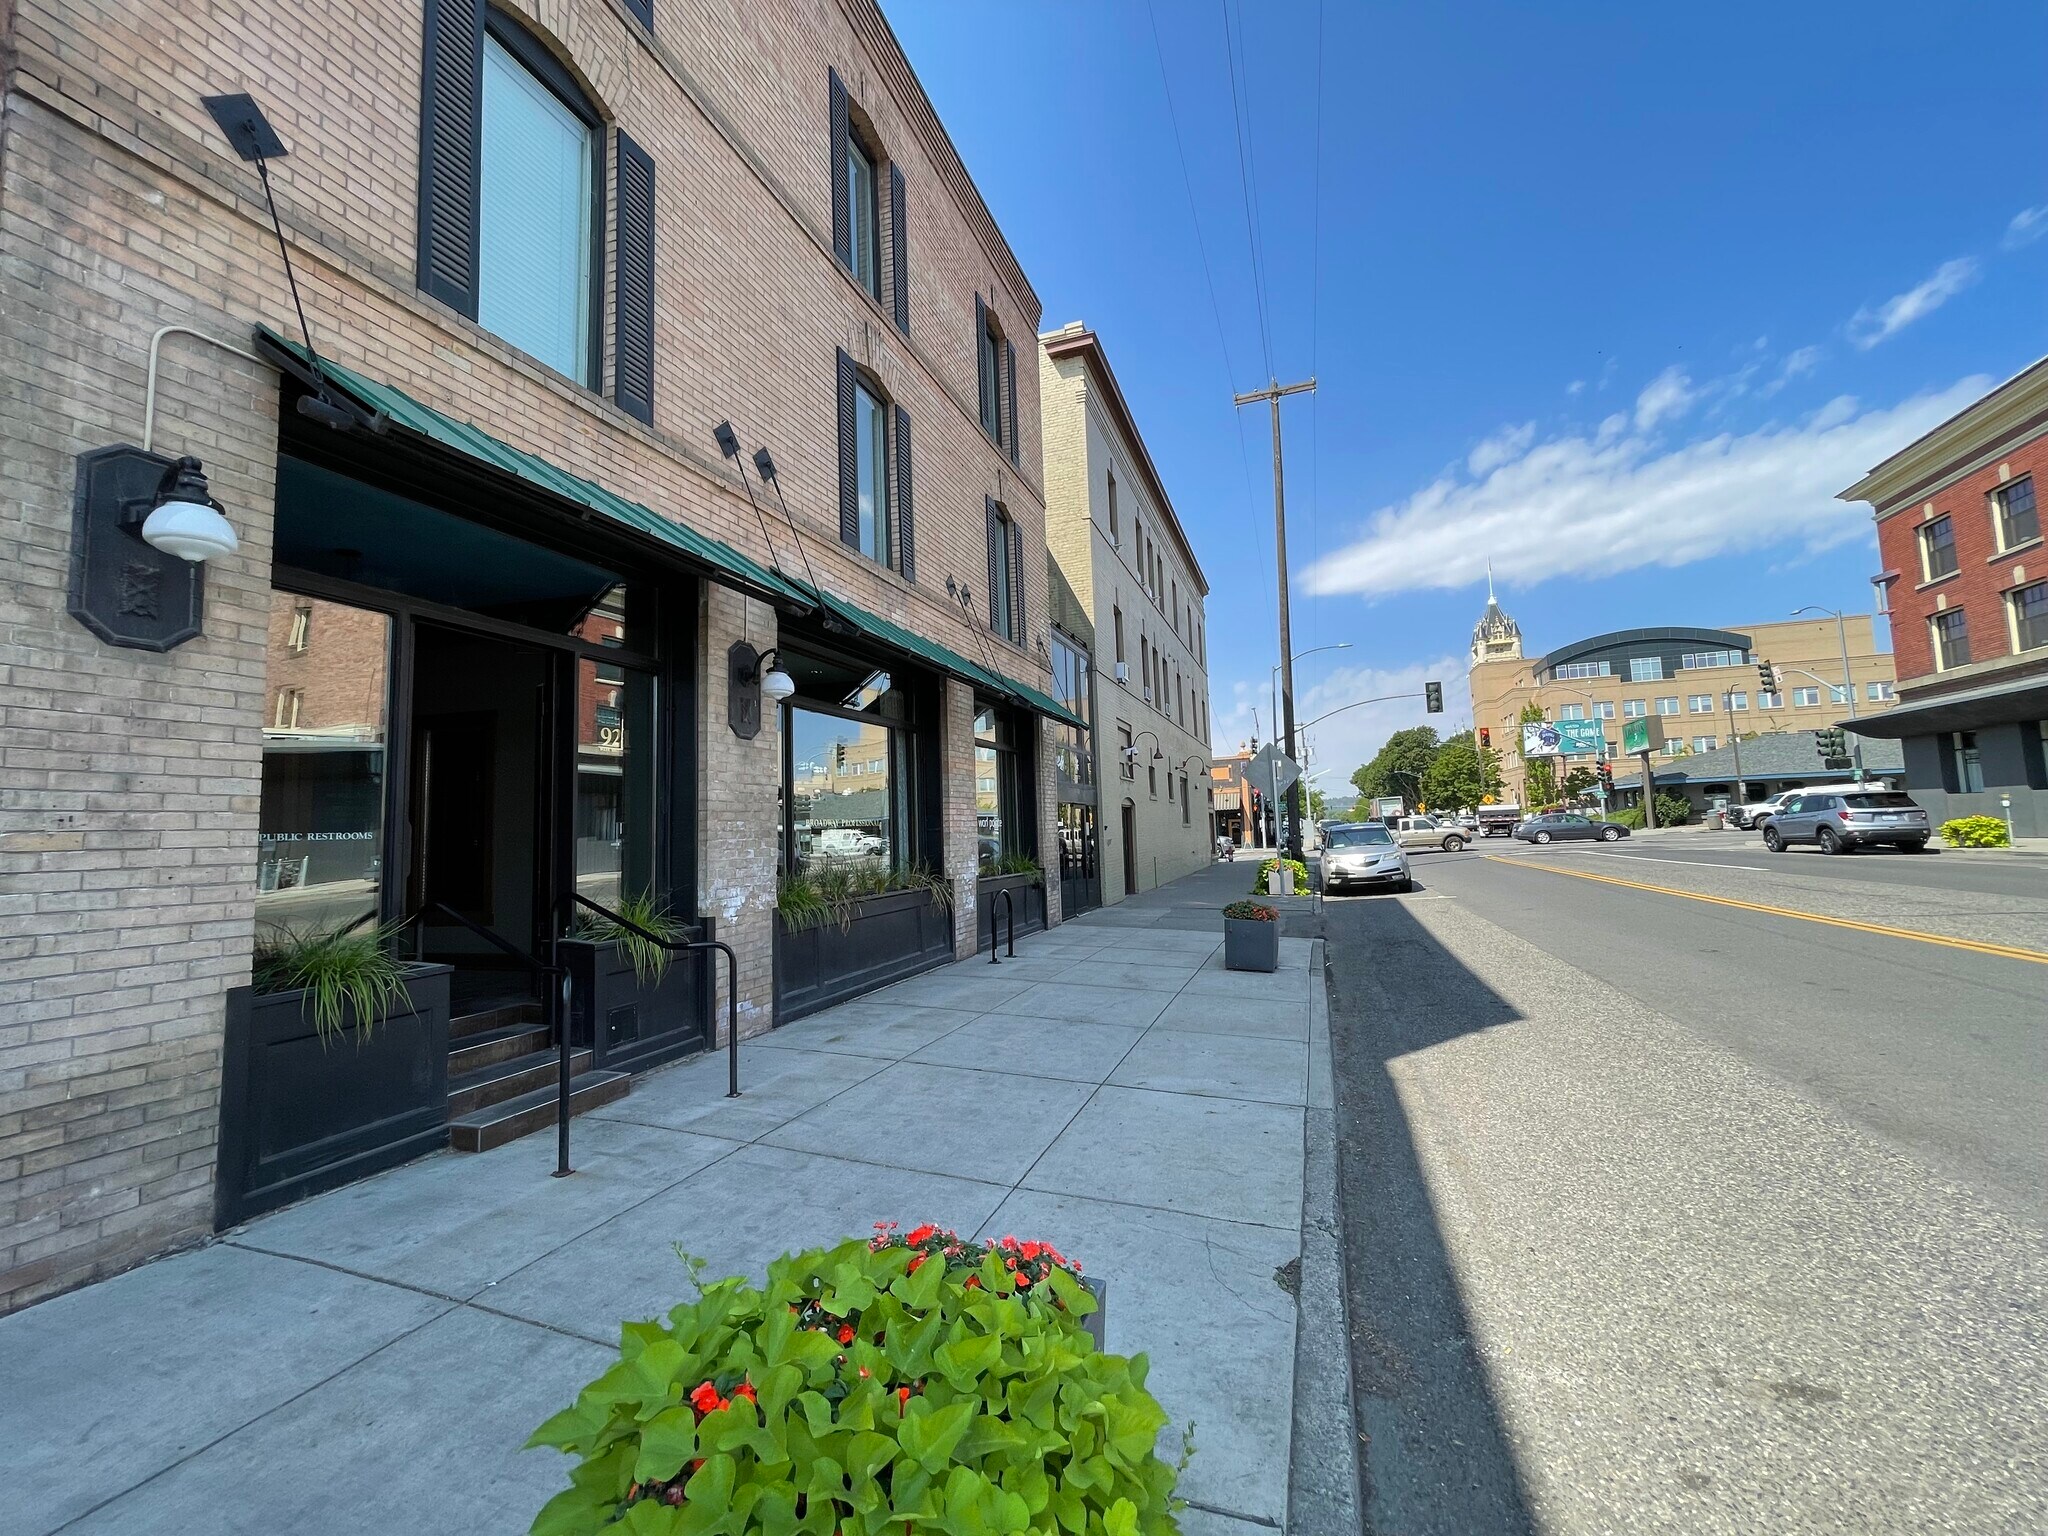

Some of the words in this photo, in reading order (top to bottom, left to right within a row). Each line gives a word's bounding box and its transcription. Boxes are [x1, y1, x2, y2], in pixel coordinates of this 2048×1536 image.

[1566, 729, 1579, 738] THE
[259, 832, 303, 842] PUBLIC
[307, 831, 373, 841] RESTROOMS
